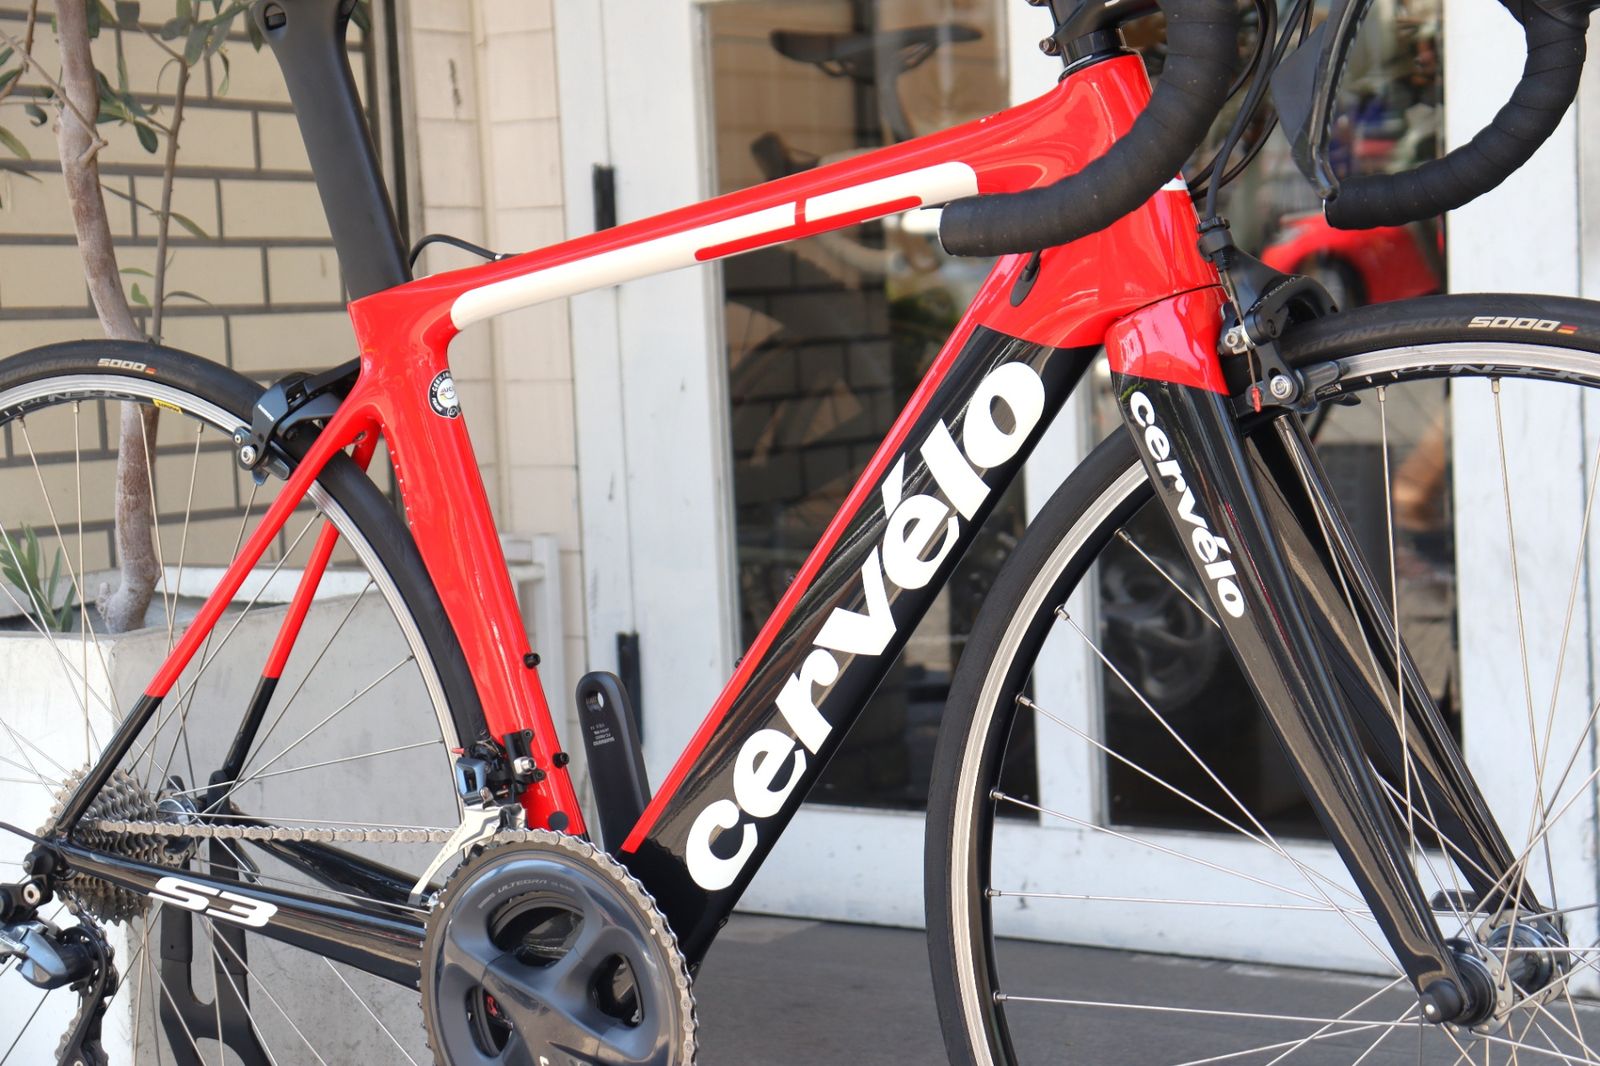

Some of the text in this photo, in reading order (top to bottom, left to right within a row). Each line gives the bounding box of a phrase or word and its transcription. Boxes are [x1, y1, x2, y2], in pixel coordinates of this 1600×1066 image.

[1467, 316, 1560, 332] 5000
[97, 358, 147, 371] 5000
[1130, 391, 1245, 618] cervélo
[685, 362, 1046, 891] cervélo
[148, 877, 279, 927] S3
